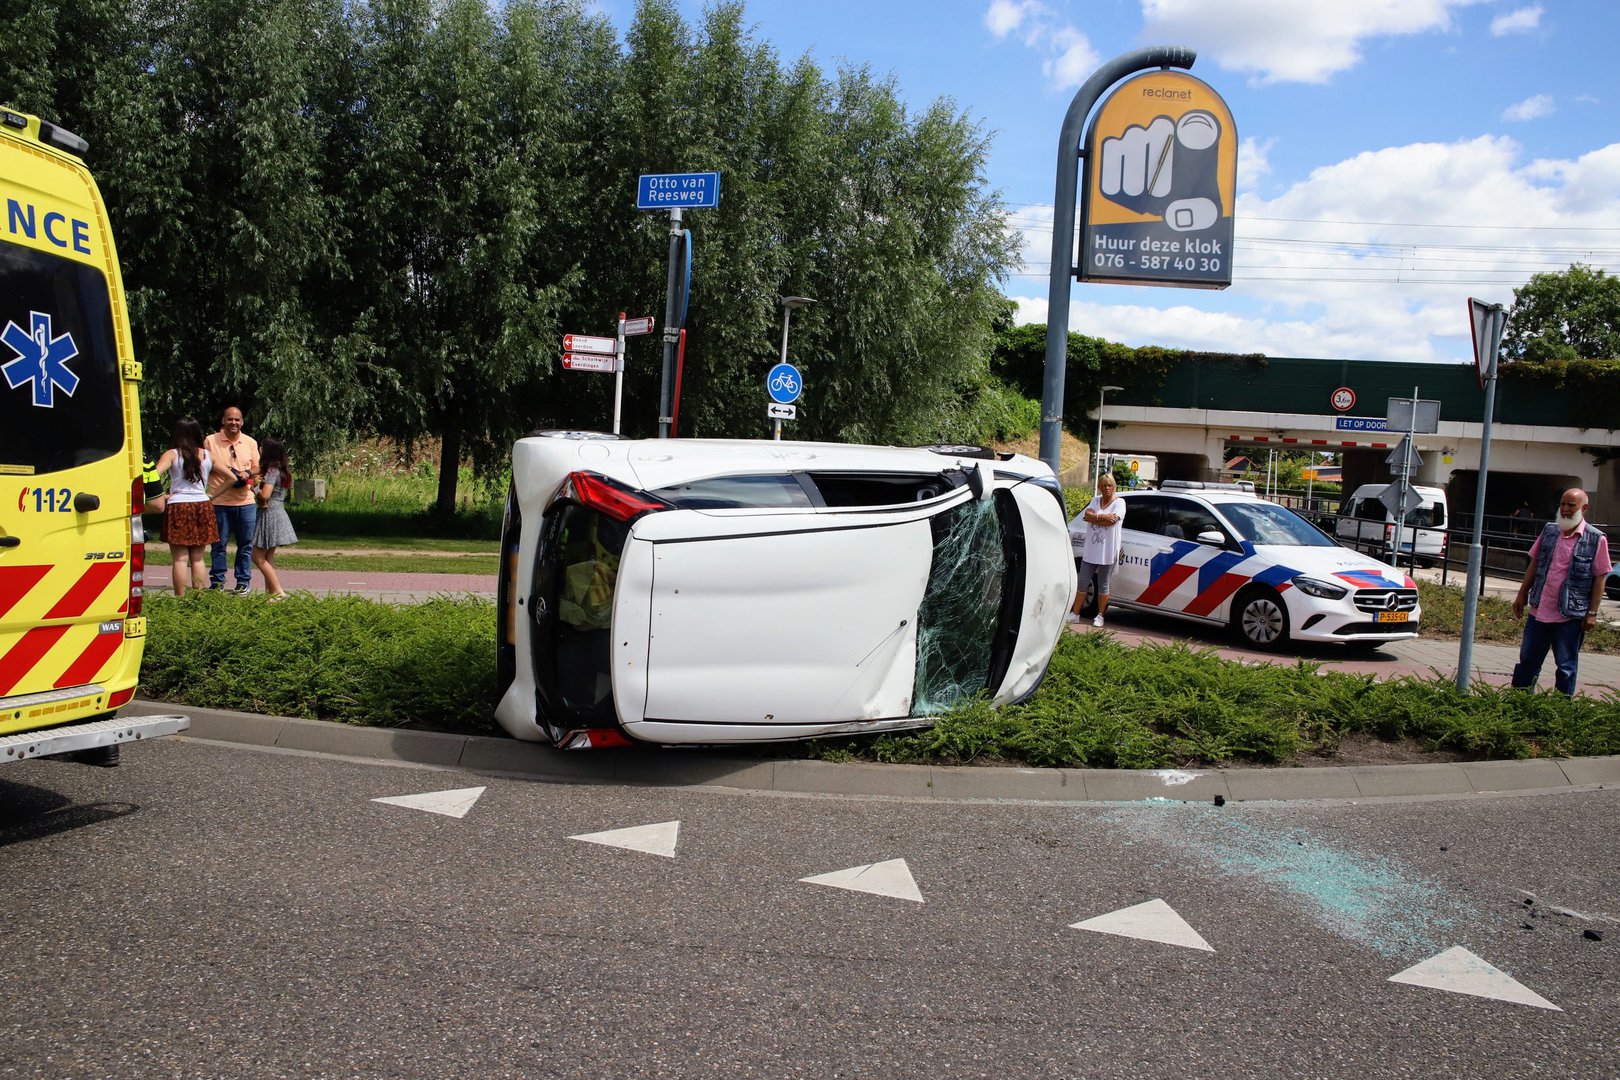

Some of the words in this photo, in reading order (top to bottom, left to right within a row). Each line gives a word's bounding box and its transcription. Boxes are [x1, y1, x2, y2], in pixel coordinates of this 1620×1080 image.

[1142, 87, 1192, 100] reclanet
[649, 177, 678, 189] Otto
[682, 178, 705, 188] van
[648, 189, 704, 203] Reesweg
[1095, 234, 1136, 251] Huur
[1140, 236, 1180, 252] deze
[1185, 237, 1222, 255] klok
[1094, 253, 1125, 267] 076
[1140, 255, 1171, 270] 587
[1173, 257, 1196, 271] 40
[1199, 258, 1220, 272] 30
[1339, 419, 1352, 428] LET
[1354, 420, 1364, 428] OP
[32, 487, 72, 513] 1-1-2
[107, 551, 124, 559] CDI
[1119, 554, 1149, 567] OLITIE
[101, 623, 120, 631] WAS
